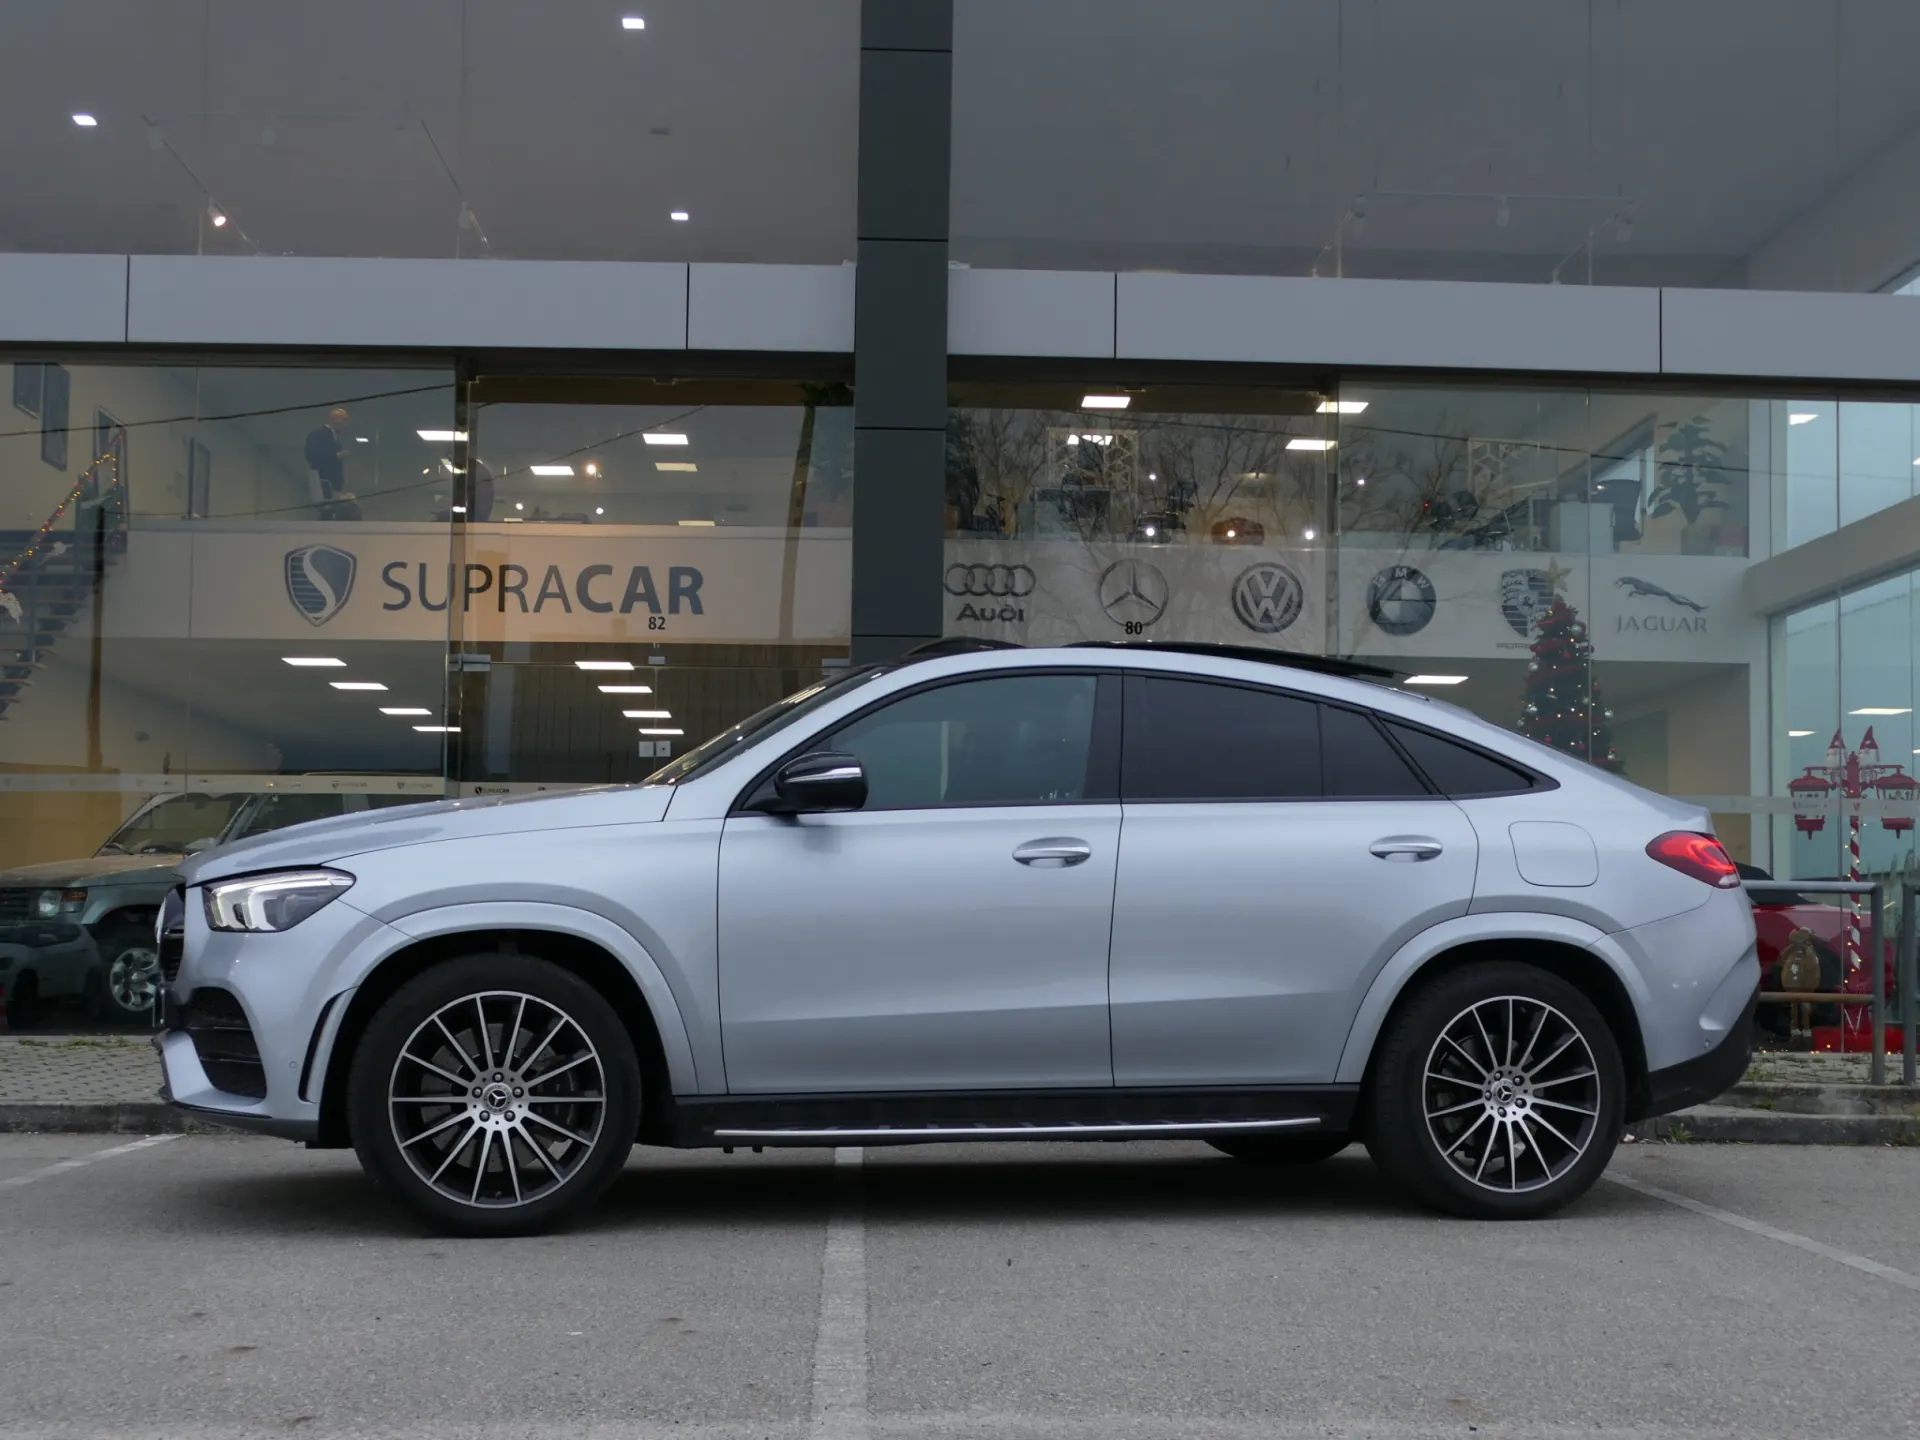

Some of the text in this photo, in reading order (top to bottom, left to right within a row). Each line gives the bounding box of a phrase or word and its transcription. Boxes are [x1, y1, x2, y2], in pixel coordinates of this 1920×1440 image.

[382, 561, 705, 615] SUPRACAR
[1372, 567, 1430, 589] BMW
[955, 602, 1025, 622] Audi
[648, 616, 666, 631] 82
[1125, 621, 1143, 635] 80
[1616, 614, 1708, 634] JAGUAR
